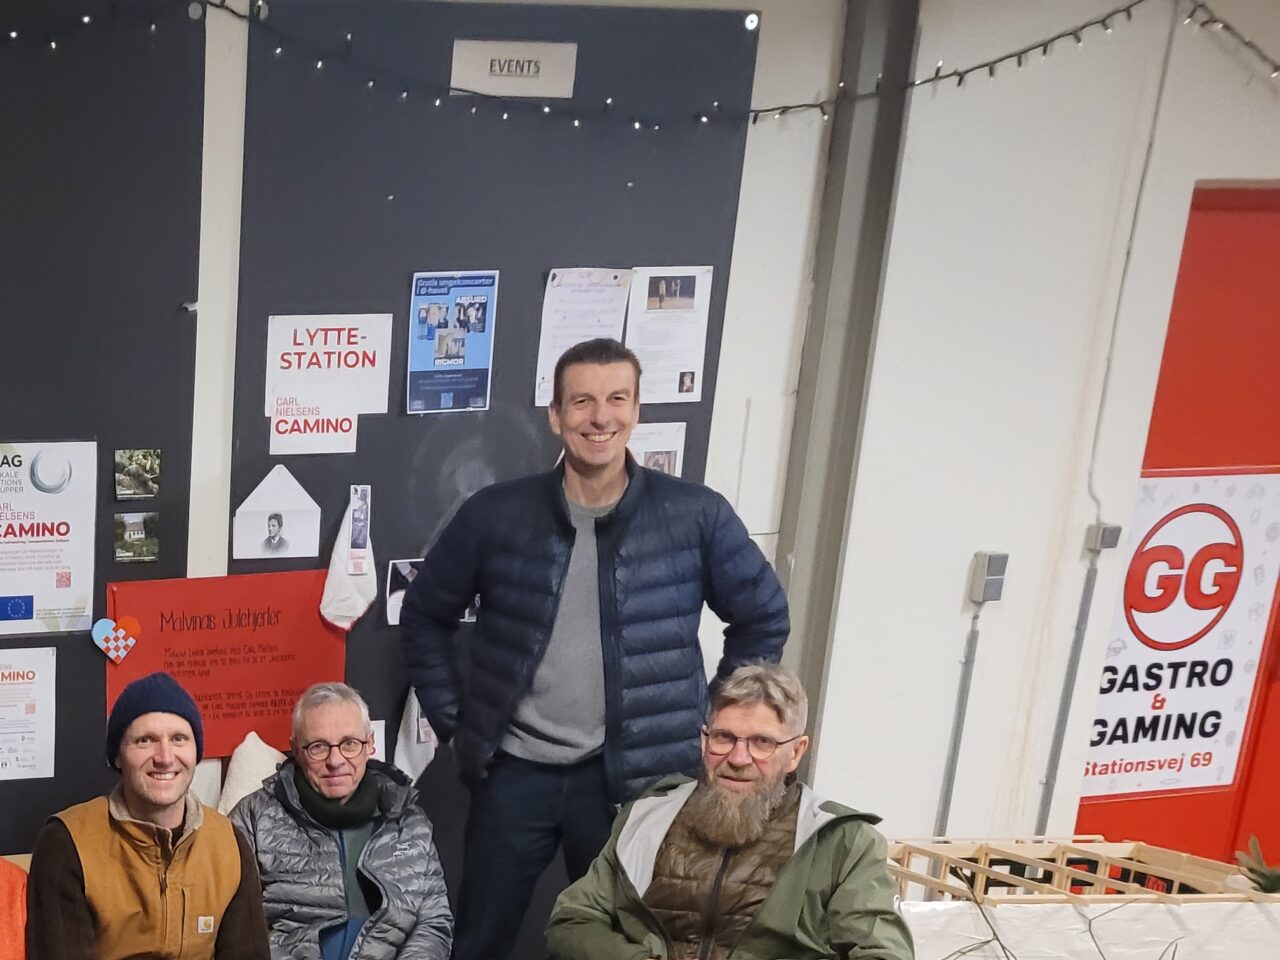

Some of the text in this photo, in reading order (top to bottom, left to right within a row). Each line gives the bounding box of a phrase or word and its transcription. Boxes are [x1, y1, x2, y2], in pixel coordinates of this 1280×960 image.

[489, 58, 541, 74] EVENTS
[293, 328, 367, 346] LYTTE-
[280, 350, 376, 369] STATION
[276, 397, 299, 407] CARL
[275, 406, 320, 417] NIELSENS
[275, 417, 353, 435] CAMINO
[1124, 543, 1243, 613] GG
[1099, 658, 1233, 695] GASTRO
[1151, 693, 1167, 710] &
[1089, 710, 1222, 747] GAMING
[1190, 752, 1213, 768] 69
